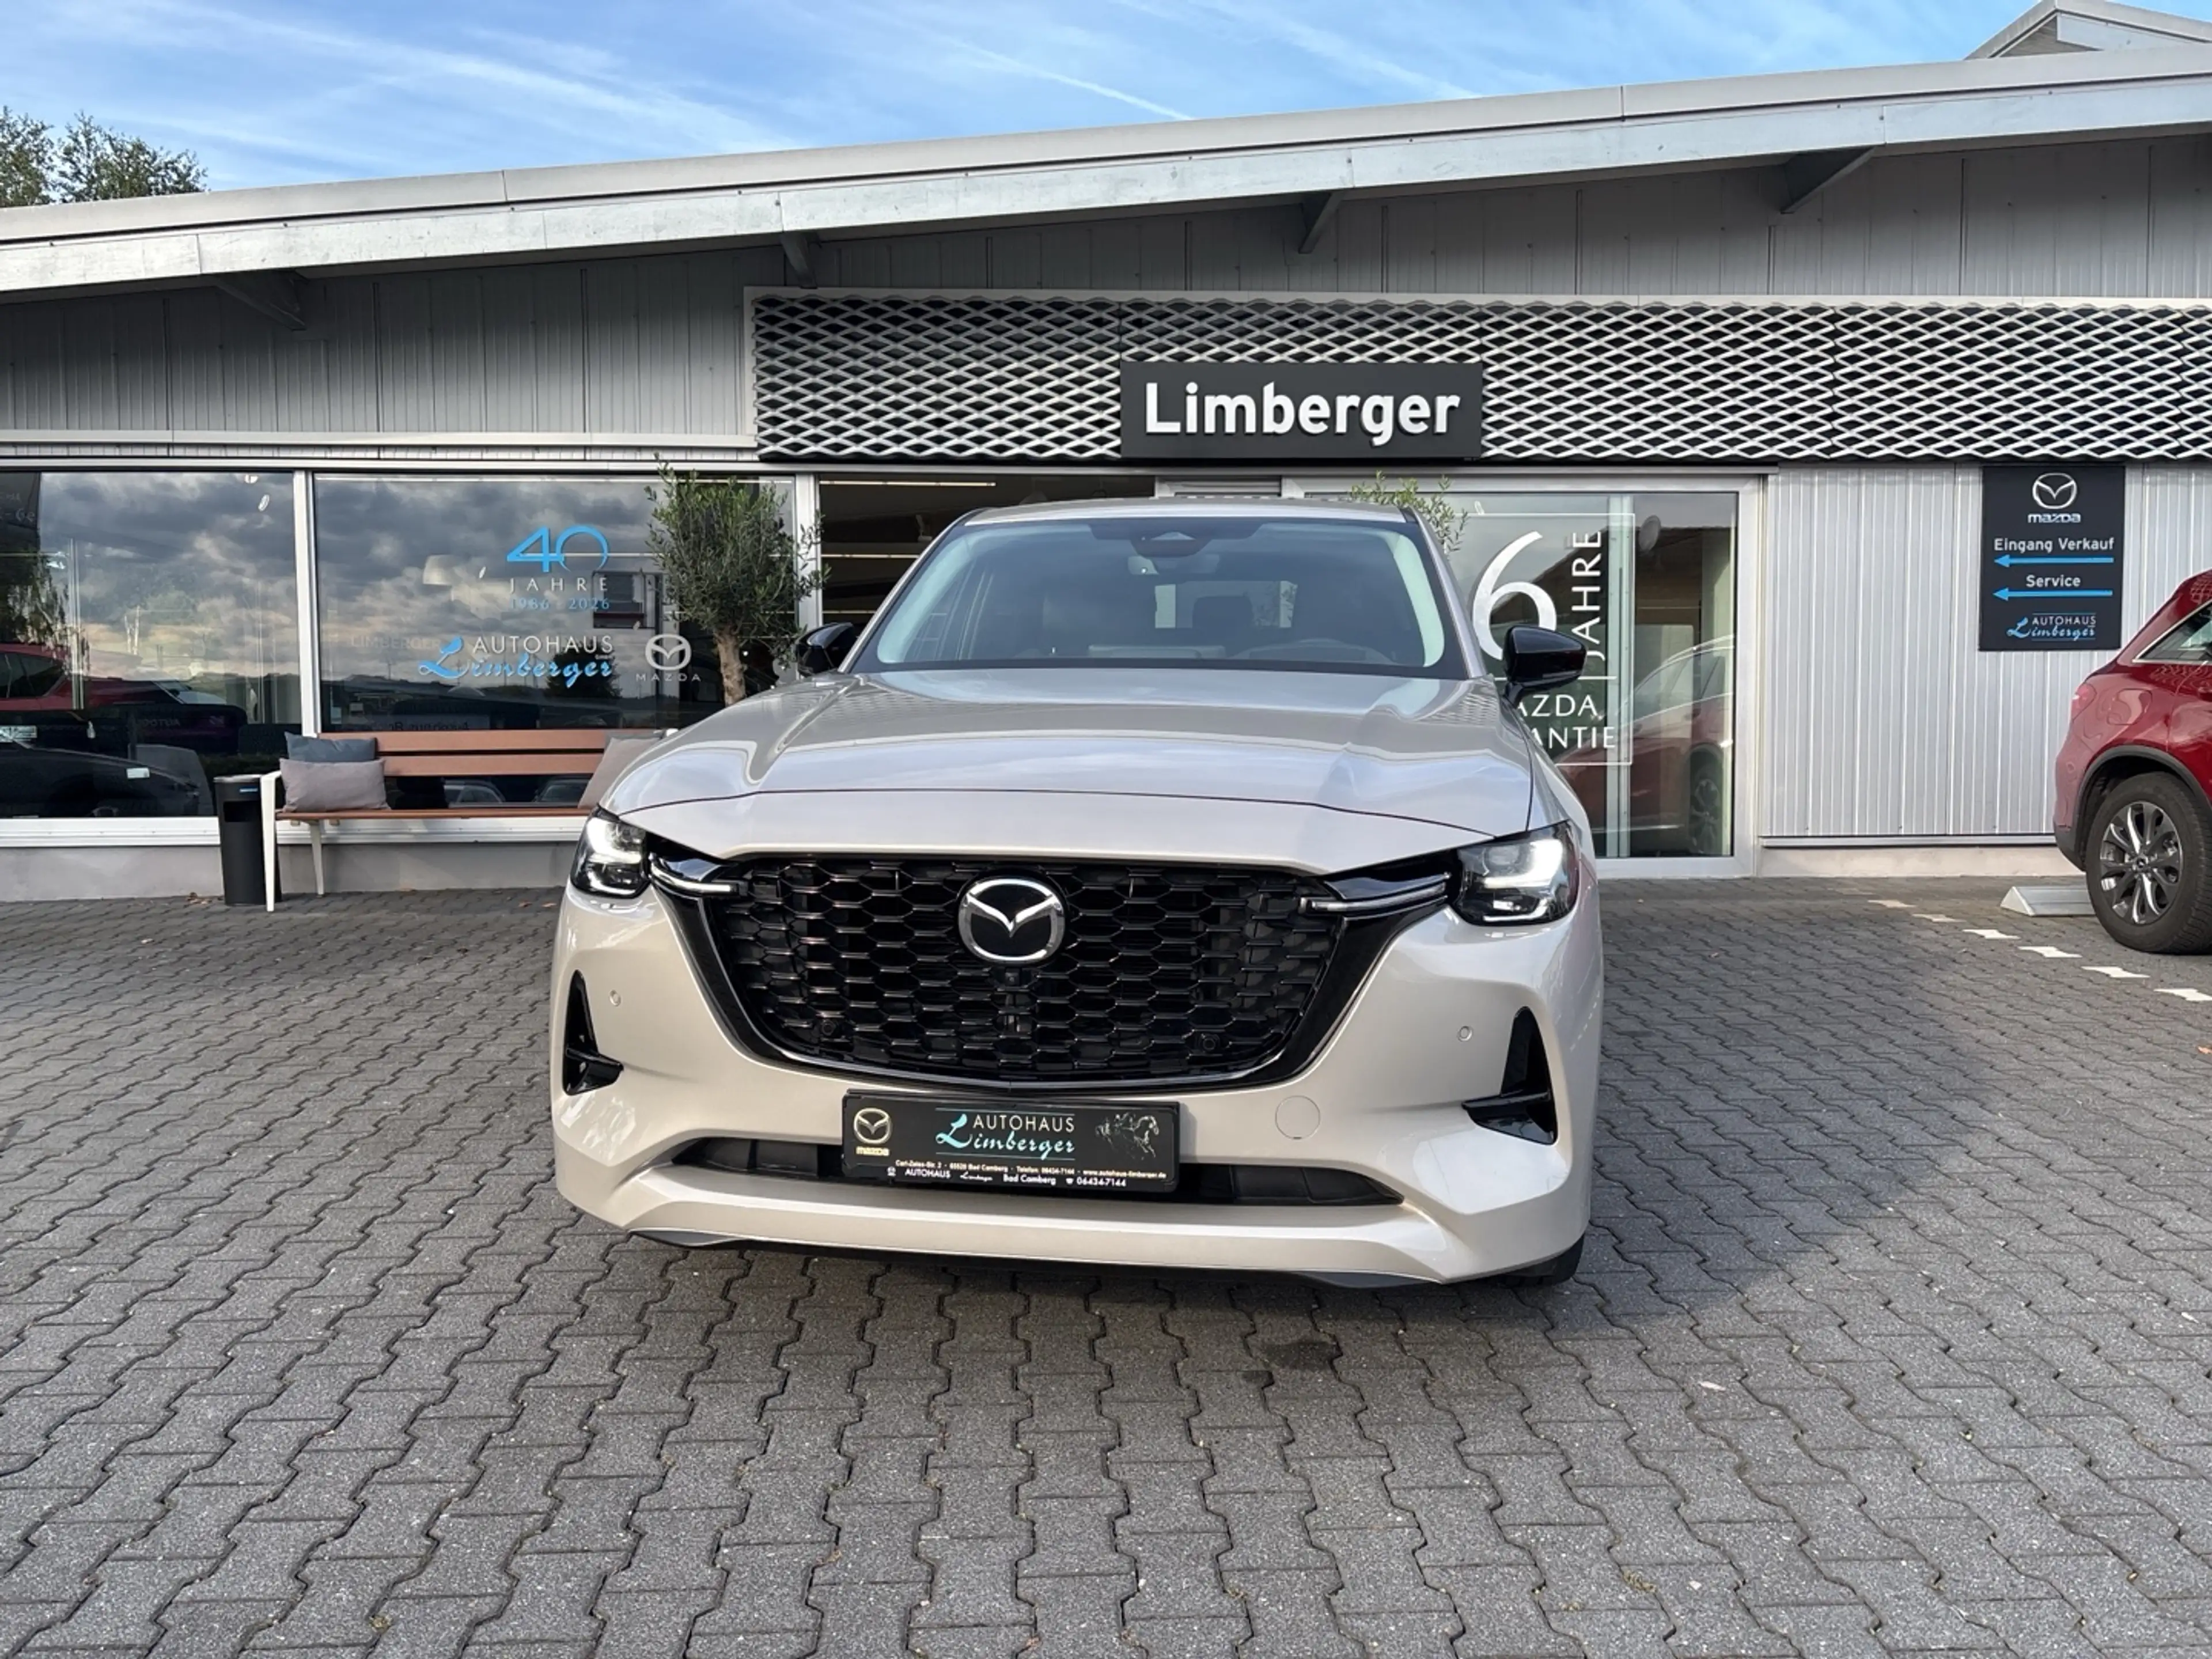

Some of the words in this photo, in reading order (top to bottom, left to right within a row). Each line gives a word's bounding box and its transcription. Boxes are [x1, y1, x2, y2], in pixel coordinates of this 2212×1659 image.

[1146, 381, 1461, 446] Limberger
[507, 525, 609, 573] 40
[1994, 537, 2053, 553] Eingang
[2058, 537, 2115, 551] Verkauf
[510, 577, 608, 594] JAHRE
[2026, 574, 2081, 588] Service
[510, 597, 550, 609] 1986
[569, 597, 609, 610] 2026
[1472, 531, 1557, 661] 6
[1571, 531, 1606, 661] JAHRE
[2006, 617, 2096, 641] Limberger
[2032, 616, 2096, 626] AUTOHAUS
[472, 635, 613, 653] AUTOHAUS
[418, 635, 612, 688] Limberger
[636, 673, 701, 681] MAZDA
[1517, 694, 1599, 717] AZDA
[972, 1115, 1075, 1133] AUTOHAUS
[935, 1113, 1075, 1160] Limberger
[904, 1168, 951, 1179] AUTOHAUS
[1003, 1173, 1019, 1183] Bad
[1020, 1173, 1056, 1186] Camberg
